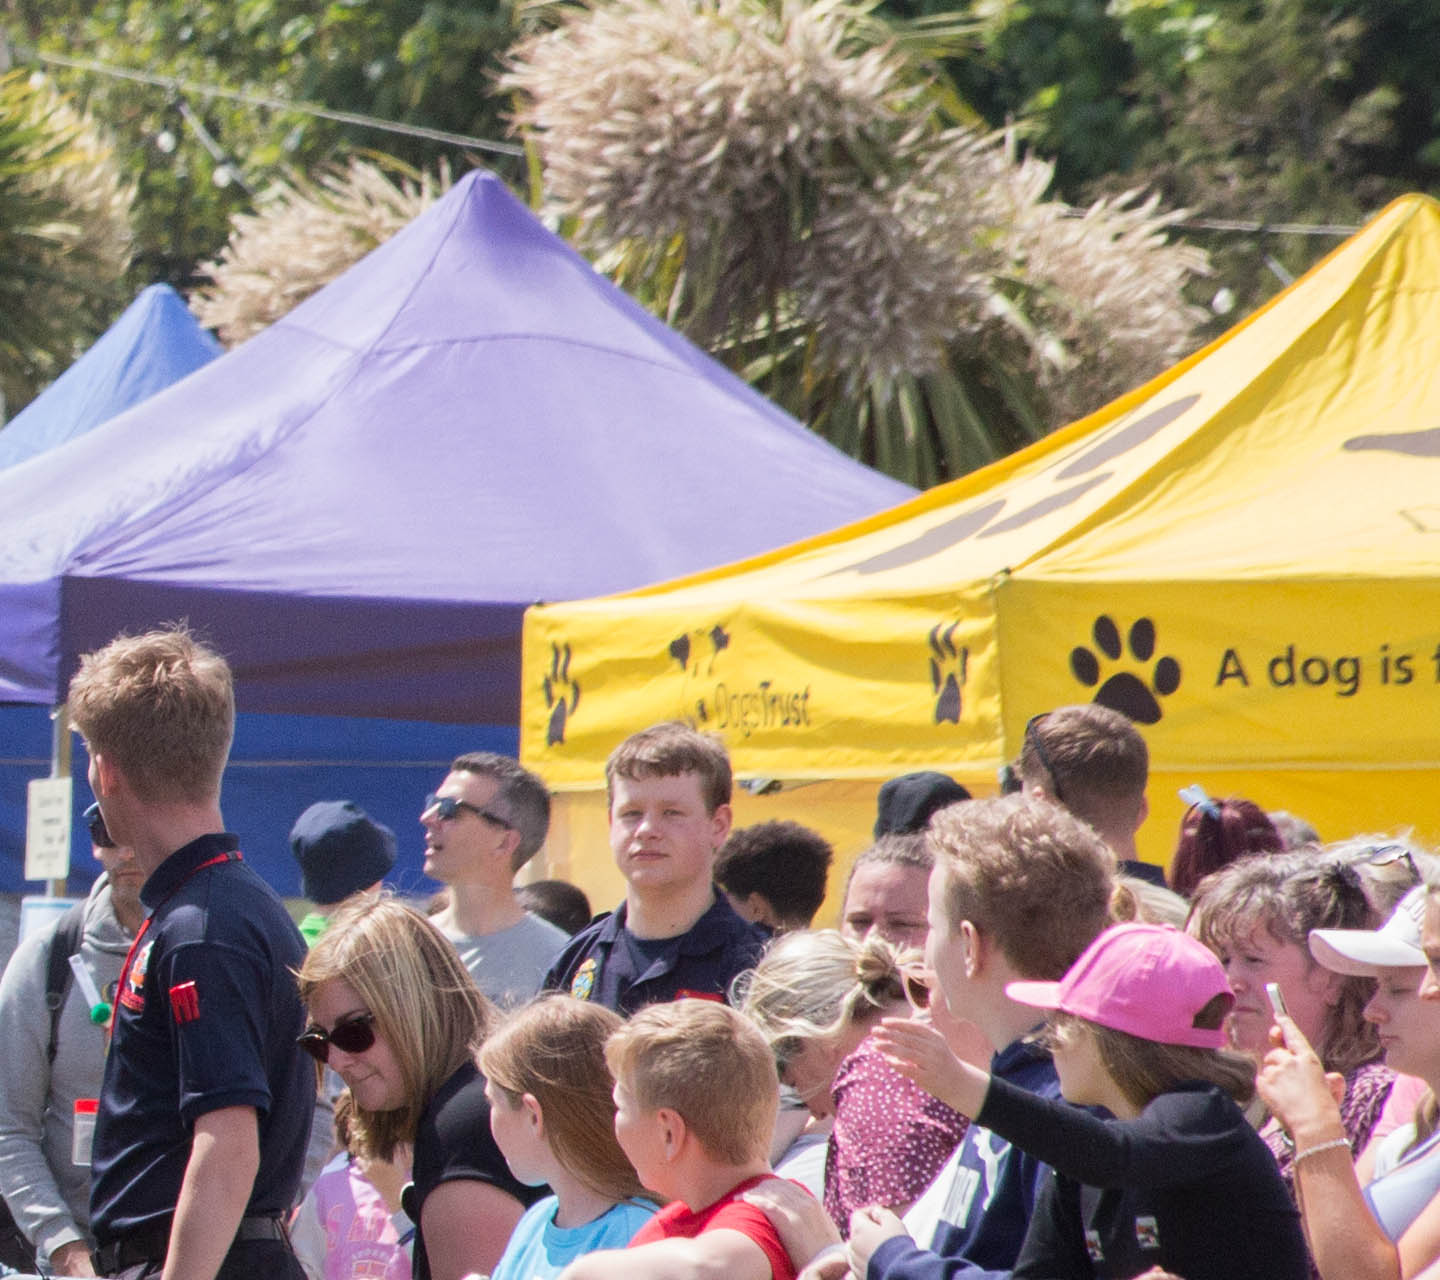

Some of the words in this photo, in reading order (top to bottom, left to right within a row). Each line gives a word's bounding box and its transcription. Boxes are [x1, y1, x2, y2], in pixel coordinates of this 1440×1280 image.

[1215, 648, 1249, 687] A
[1268, 644, 1361, 697] dog
[1380, 643, 1415, 685] is
